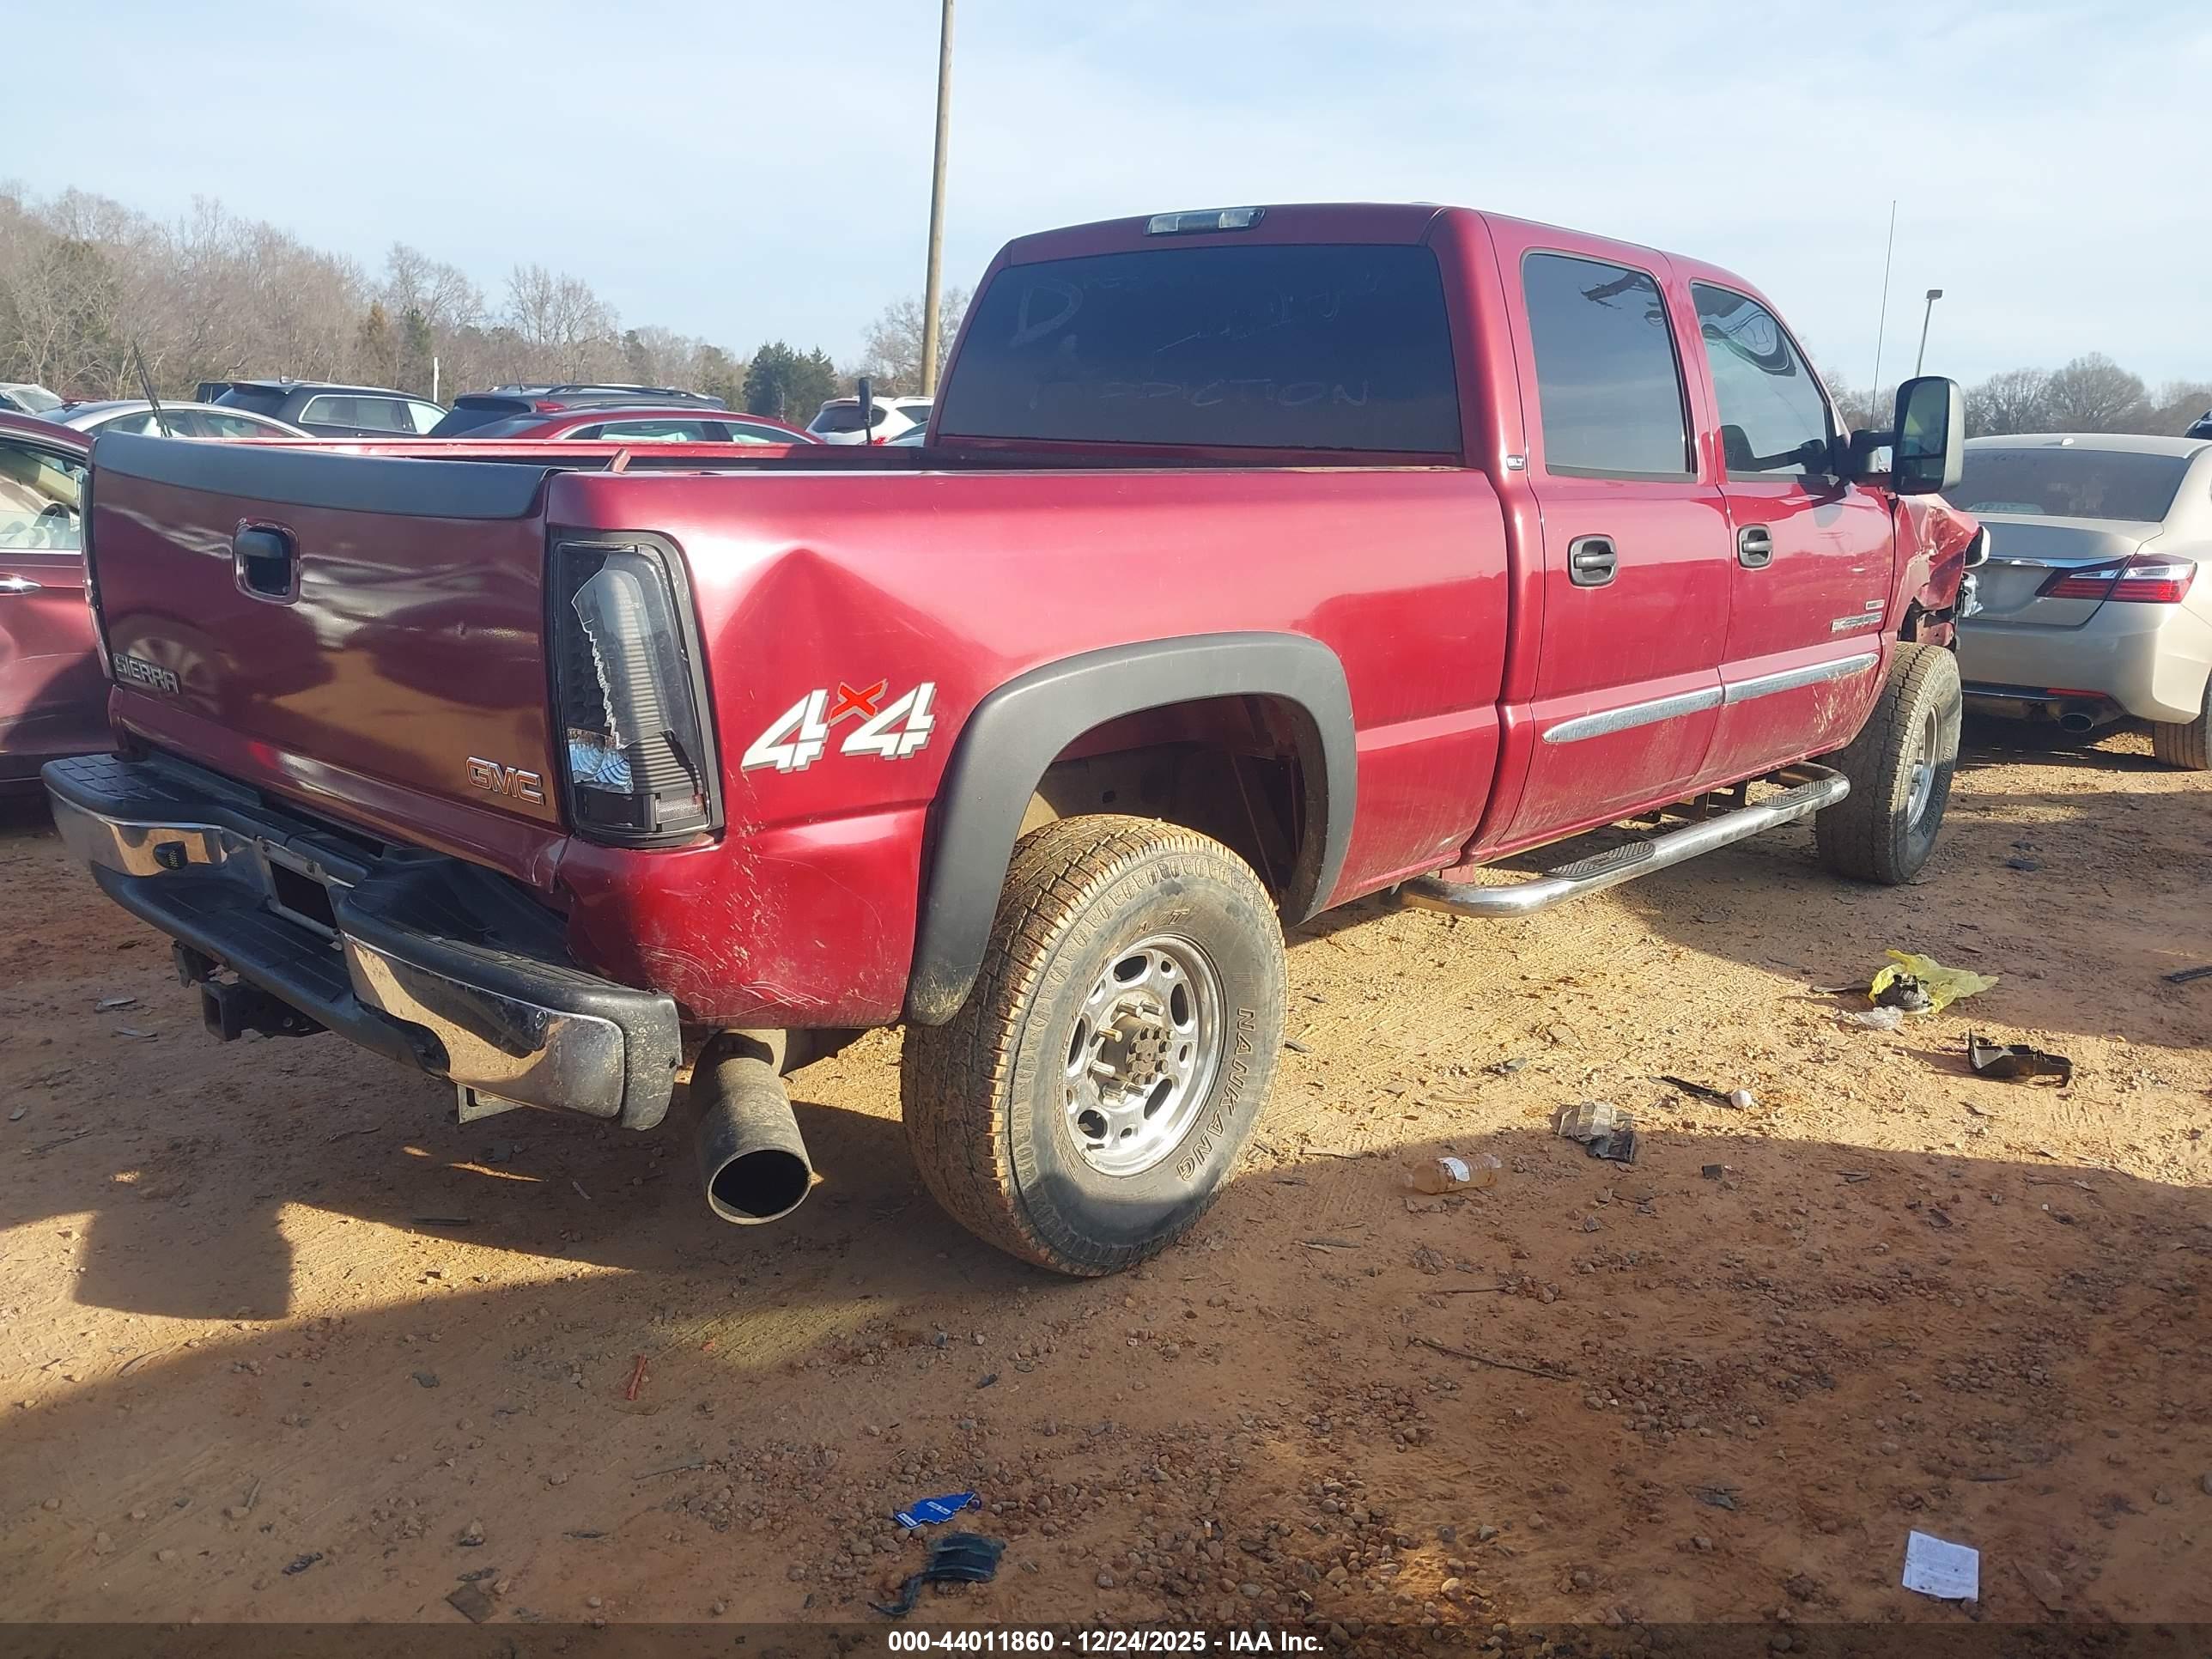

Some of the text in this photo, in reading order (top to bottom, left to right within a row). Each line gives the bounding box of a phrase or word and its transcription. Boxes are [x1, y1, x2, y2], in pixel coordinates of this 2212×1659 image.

[113, 654, 179, 695] SIERRA
[466, 757, 544, 805] GMC
[1176, 1007, 1256, 1182] NANKANG
